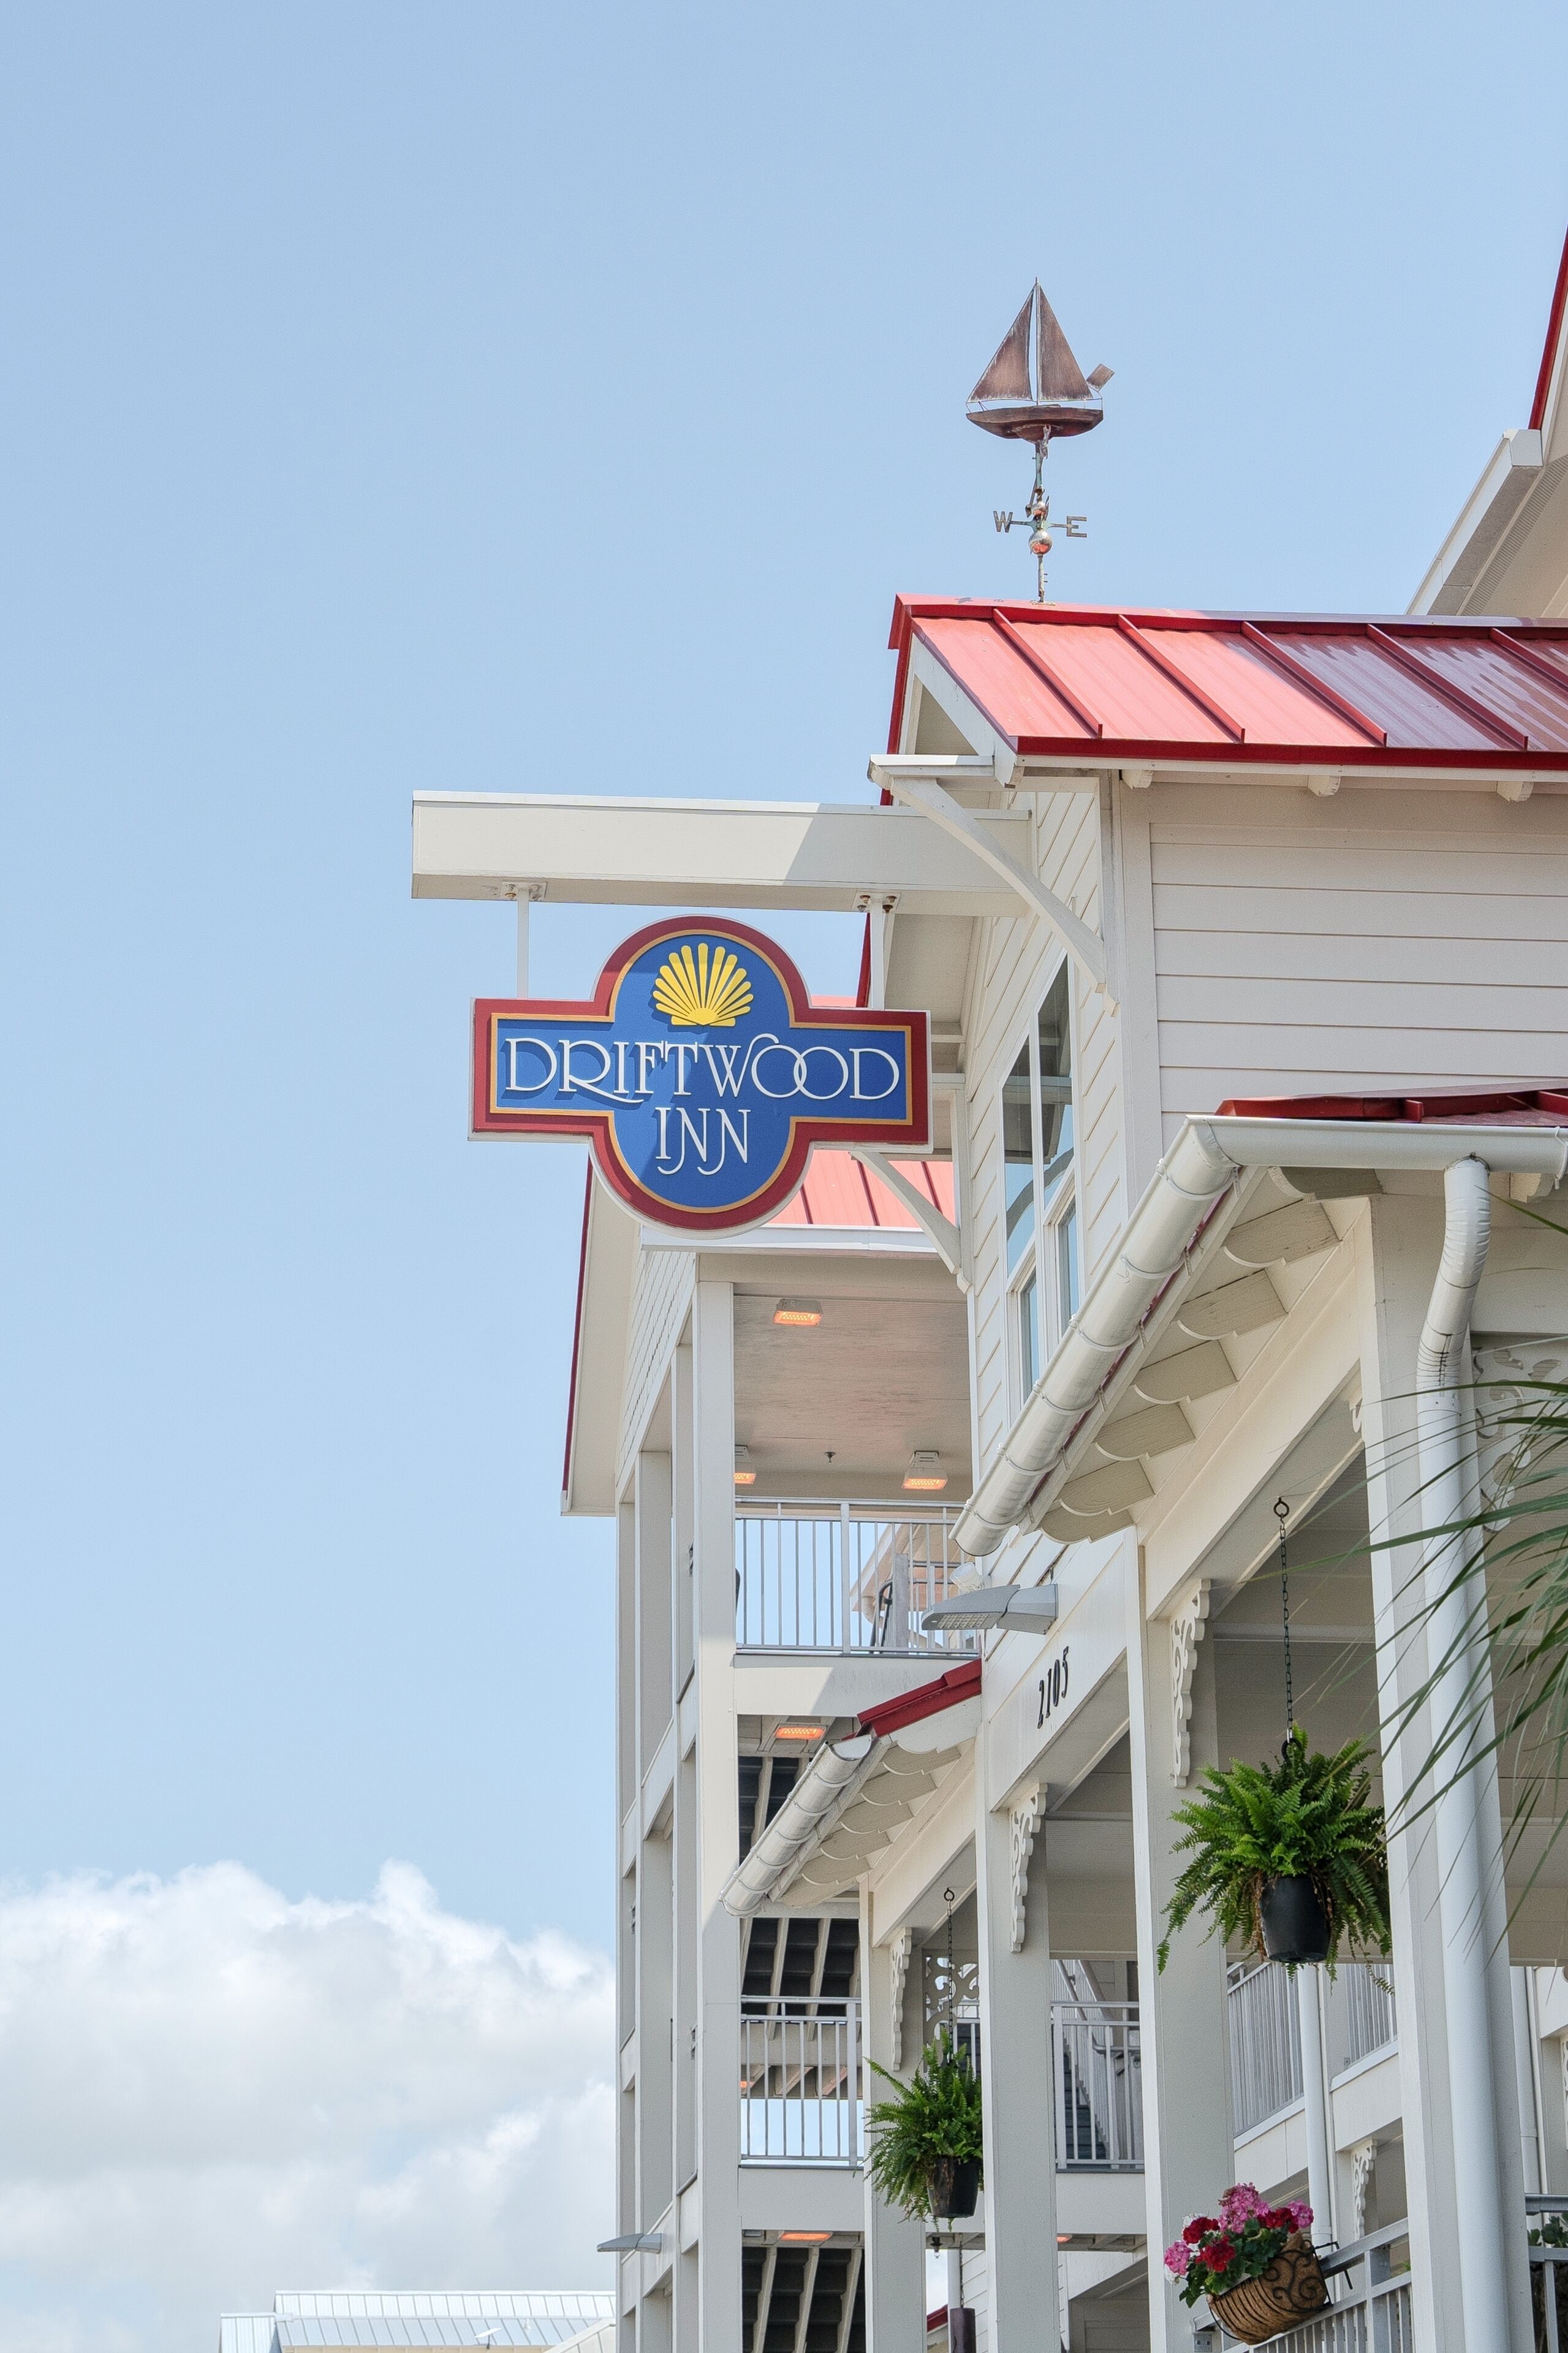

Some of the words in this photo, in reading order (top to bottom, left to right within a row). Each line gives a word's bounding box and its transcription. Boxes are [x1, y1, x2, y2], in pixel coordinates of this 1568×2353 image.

[993, 510, 1013, 532] W
[1066, 516, 1087, 537] E
[505, 1033, 900, 1103] DRIFTWOOD
[655, 1107, 751, 1175] INN
[1037, 1646, 1069, 1729] 2105
